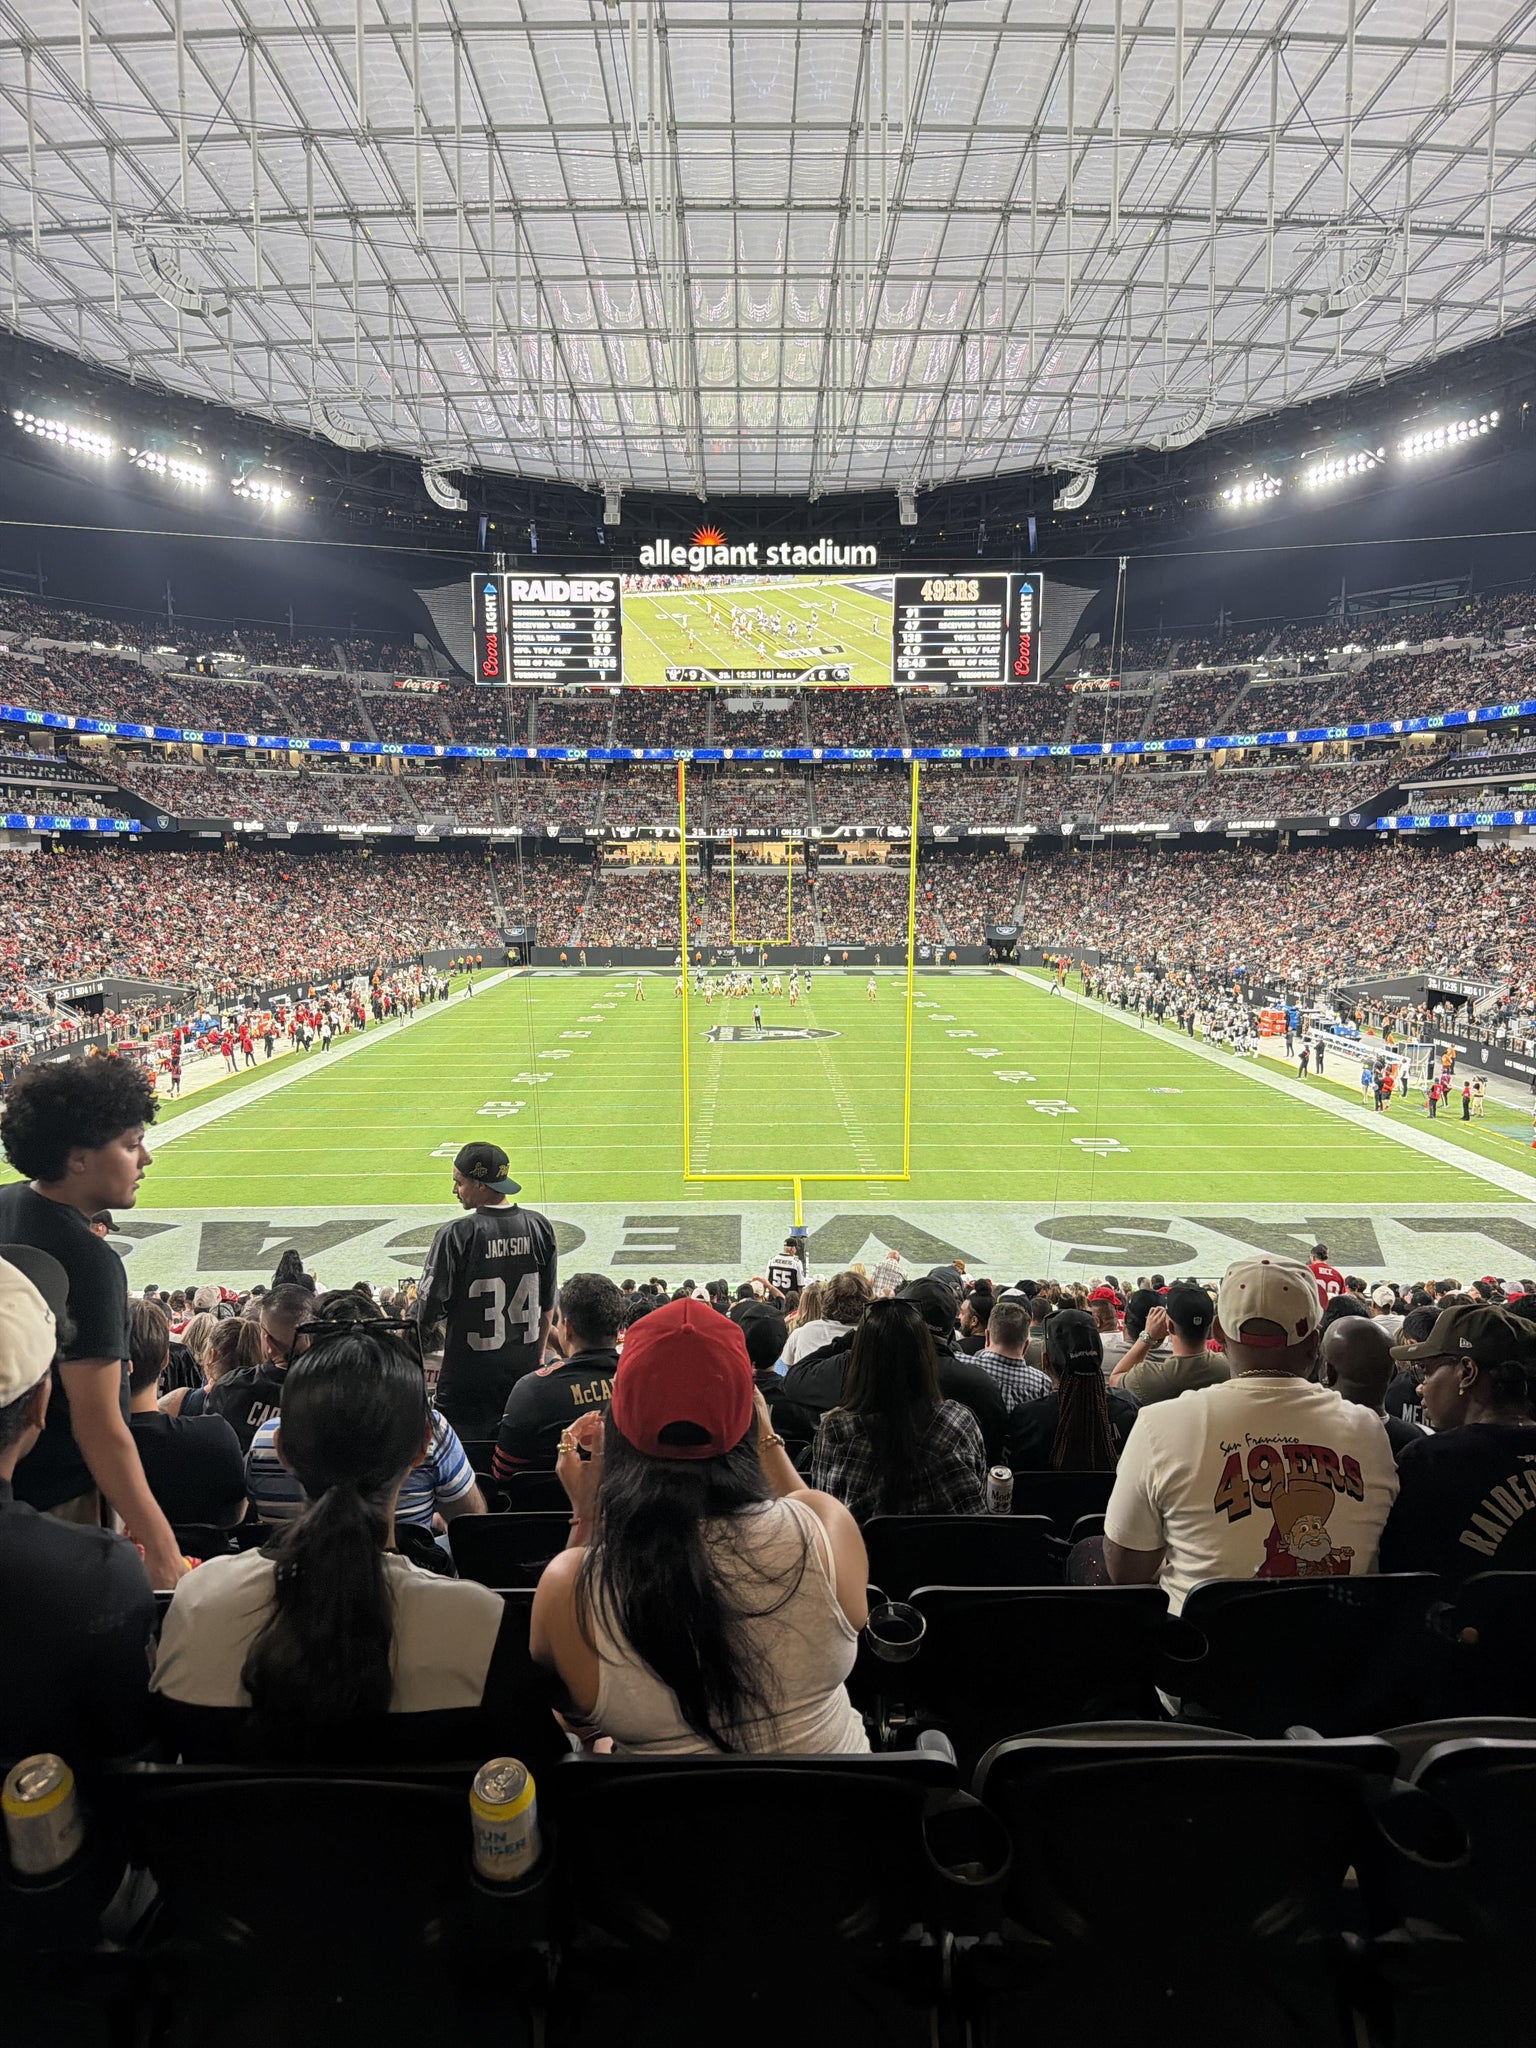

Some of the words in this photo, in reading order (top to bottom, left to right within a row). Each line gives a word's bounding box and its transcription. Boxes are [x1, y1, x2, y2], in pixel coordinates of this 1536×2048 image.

[639, 538, 758, 572] allegiant
[766, 538, 877, 566] stadium
[510, 580, 615, 602] RAIDERS
[920, 579, 979, 601] 49ERS
[485, 594, 498, 633] LIGHT
[593, 608, 609, 618] 79
[906, 608, 919, 618] 91
[1020, 594, 1032, 633] LIGHT
[593, 621, 609, 631] 69
[904, 621, 920, 631] 47
[513, 634, 535, 642] TOTAL
[902, 633, 922, 643] 138
[954, 634, 976, 642] TOTAL
[482, 633, 498, 677] Coors
[593, 646, 610, 656] 3.9
[903, 646, 921, 656] 4.9
[1014, 633, 1031, 677] Coors
[513, 659, 531, 667] TIME
[897, 658, 926, 668] 12:45
[948, 659, 965, 667] TIME
[599, 671, 605, 680] 1
[688, 671, 697, 680] 9
[818, 670, 826, 680] 6
[907, 671, 915, 680] 0
[957, 671, 999, 679] TURNOVERS
[1502, 705, 1520, 716] COX
[26, 712, 43, 723] COX
[1428, 716, 1444, 727] COX
[98, 722, 117, 733] COX
[1327, 727, 1348, 737] COX
[183, 731, 204, 741] COX
[1237, 736, 1258, 746] COX
[289, 739, 310, 749] COX
[1144, 741, 1164, 751] COX
[382, 745, 404, 754] COX
[476, 748, 497, 757] COX
[567, 749, 588, 758] COX
[673, 749, 694, 758] COX
[763, 749, 782, 758] COX
[852, 749, 872, 758] COX
[941, 748, 962, 758] COX
[1050, 745, 1071, 755] COX
[54, 818, 71, 829] COX
[1414, 816, 1430, 827] COX
[1476, 813, 1493, 825] COX
[115, 819, 130, 831] COX
[655, 829, 663, 837] 9
[716, 828, 738, 836] 12:35
[476, 1100, 527, 1115] 20
[1026, 1099, 1079, 1113] 20
[1070, 1137, 1132, 1153] 10
[485, 1236, 531, 1259] JACKSON
[772, 1268, 792, 1289] 55
[466, 1272, 541, 1351] 34
[1219, 1441, 1242, 1457] San
[1245, 1433, 1299, 1448] Francisco
[1214, 1444, 1364, 1524] 49ERS
